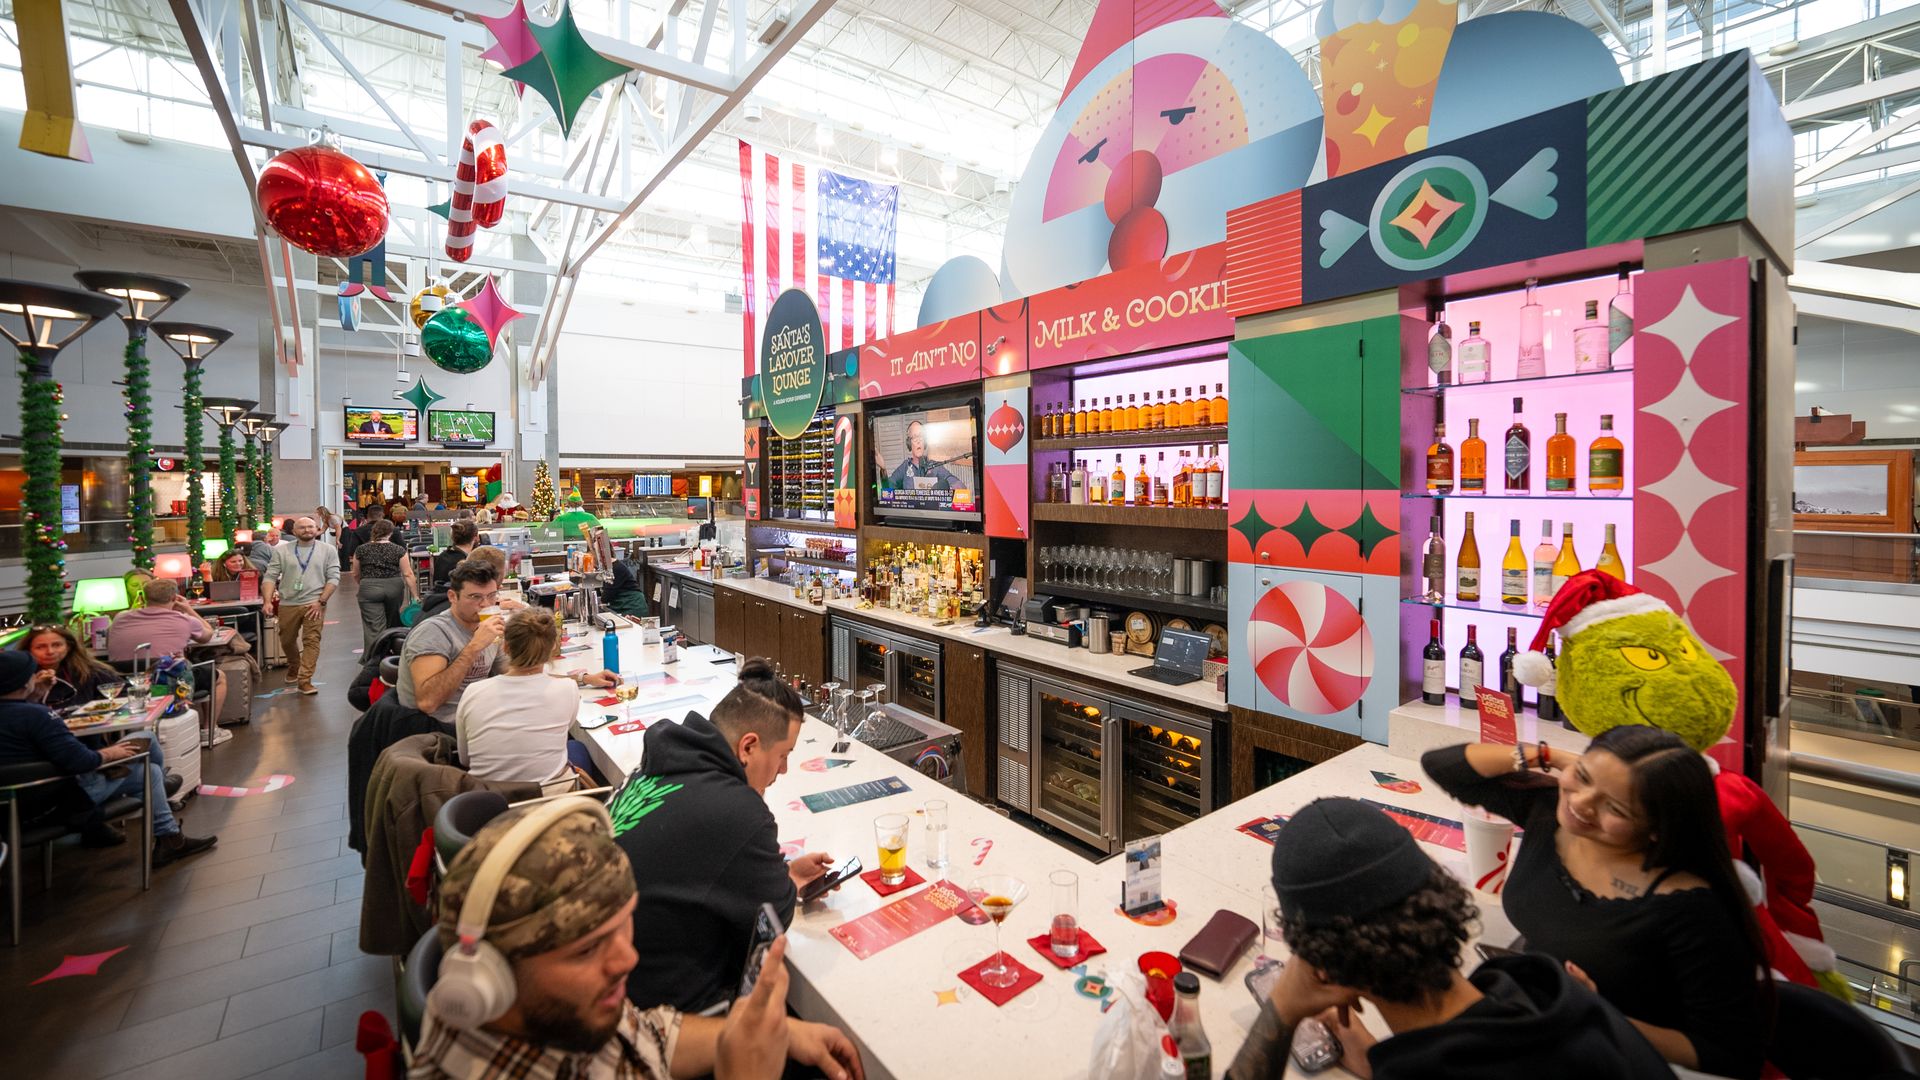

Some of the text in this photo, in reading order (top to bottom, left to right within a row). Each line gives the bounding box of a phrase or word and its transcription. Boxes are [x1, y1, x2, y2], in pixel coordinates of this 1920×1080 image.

[771, 323, 811, 354] SANTA'S
[890, 357, 903, 376] IT
[906, 347, 948, 375] AIN'T
[949, 340, 977, 367] NO
[1035, 310, 1097, 348] MILK
[1101, 307, 1121, 332] &
[769, 345, 816, 373] LAYOVER
[772, 367, 811, 395] LOUNGE
